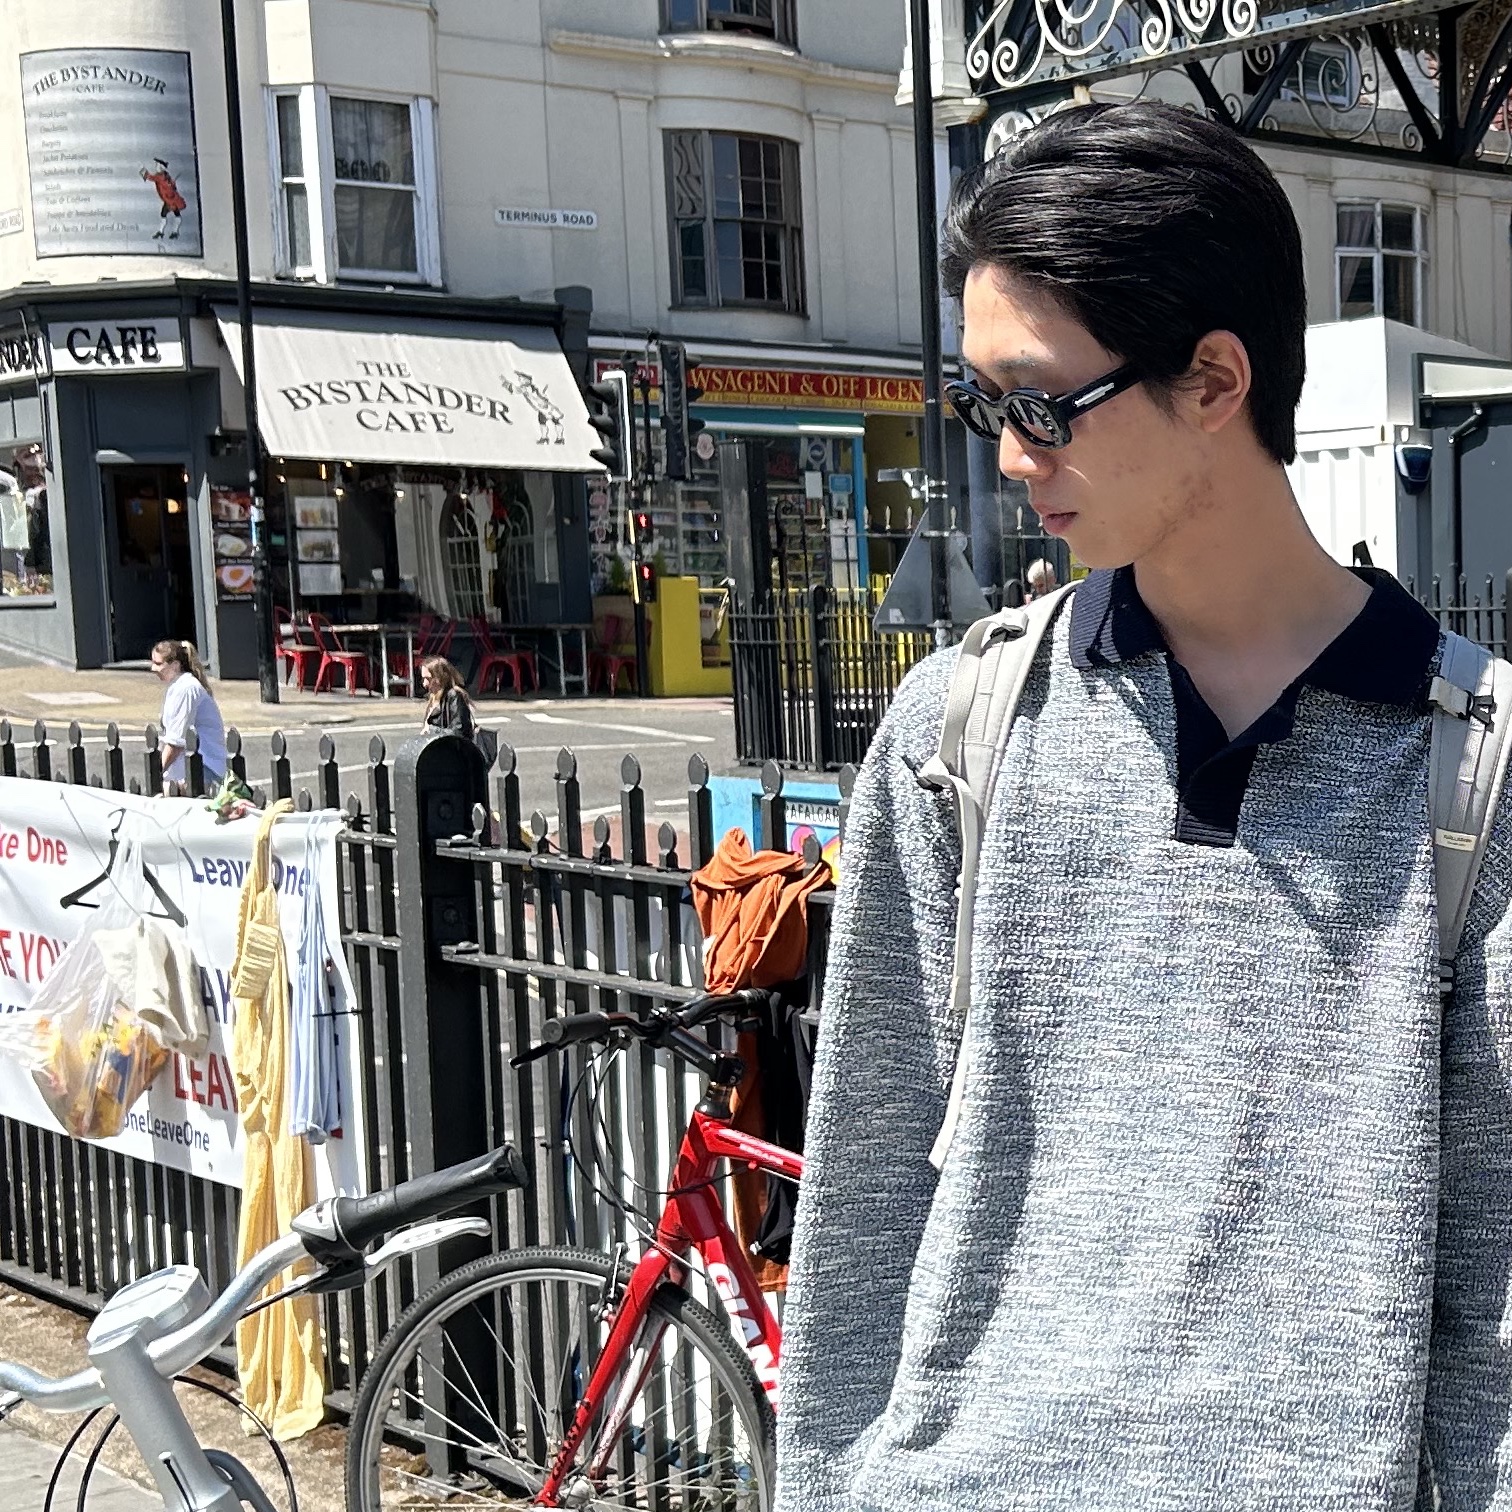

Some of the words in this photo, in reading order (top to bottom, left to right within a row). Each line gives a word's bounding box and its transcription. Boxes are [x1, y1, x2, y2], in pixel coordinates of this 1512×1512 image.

[33, 71, 59, 96] THE
[60, 65, 168, 95] BYSTANDER
[499, 209, 558, 224] TERMINUS
[562, 213, 594, 226] ROAD
[66, 326, 161, 366] CAFE
[357, 360, 412, 379] THE
[800, 374, 815, 393] &
[822, 373, 861, 398] OFF
[278, 379, 514, 426] BYSTANDER
[356, 408, 455, 435] CAFE
[26, 826, 69, 866] One
